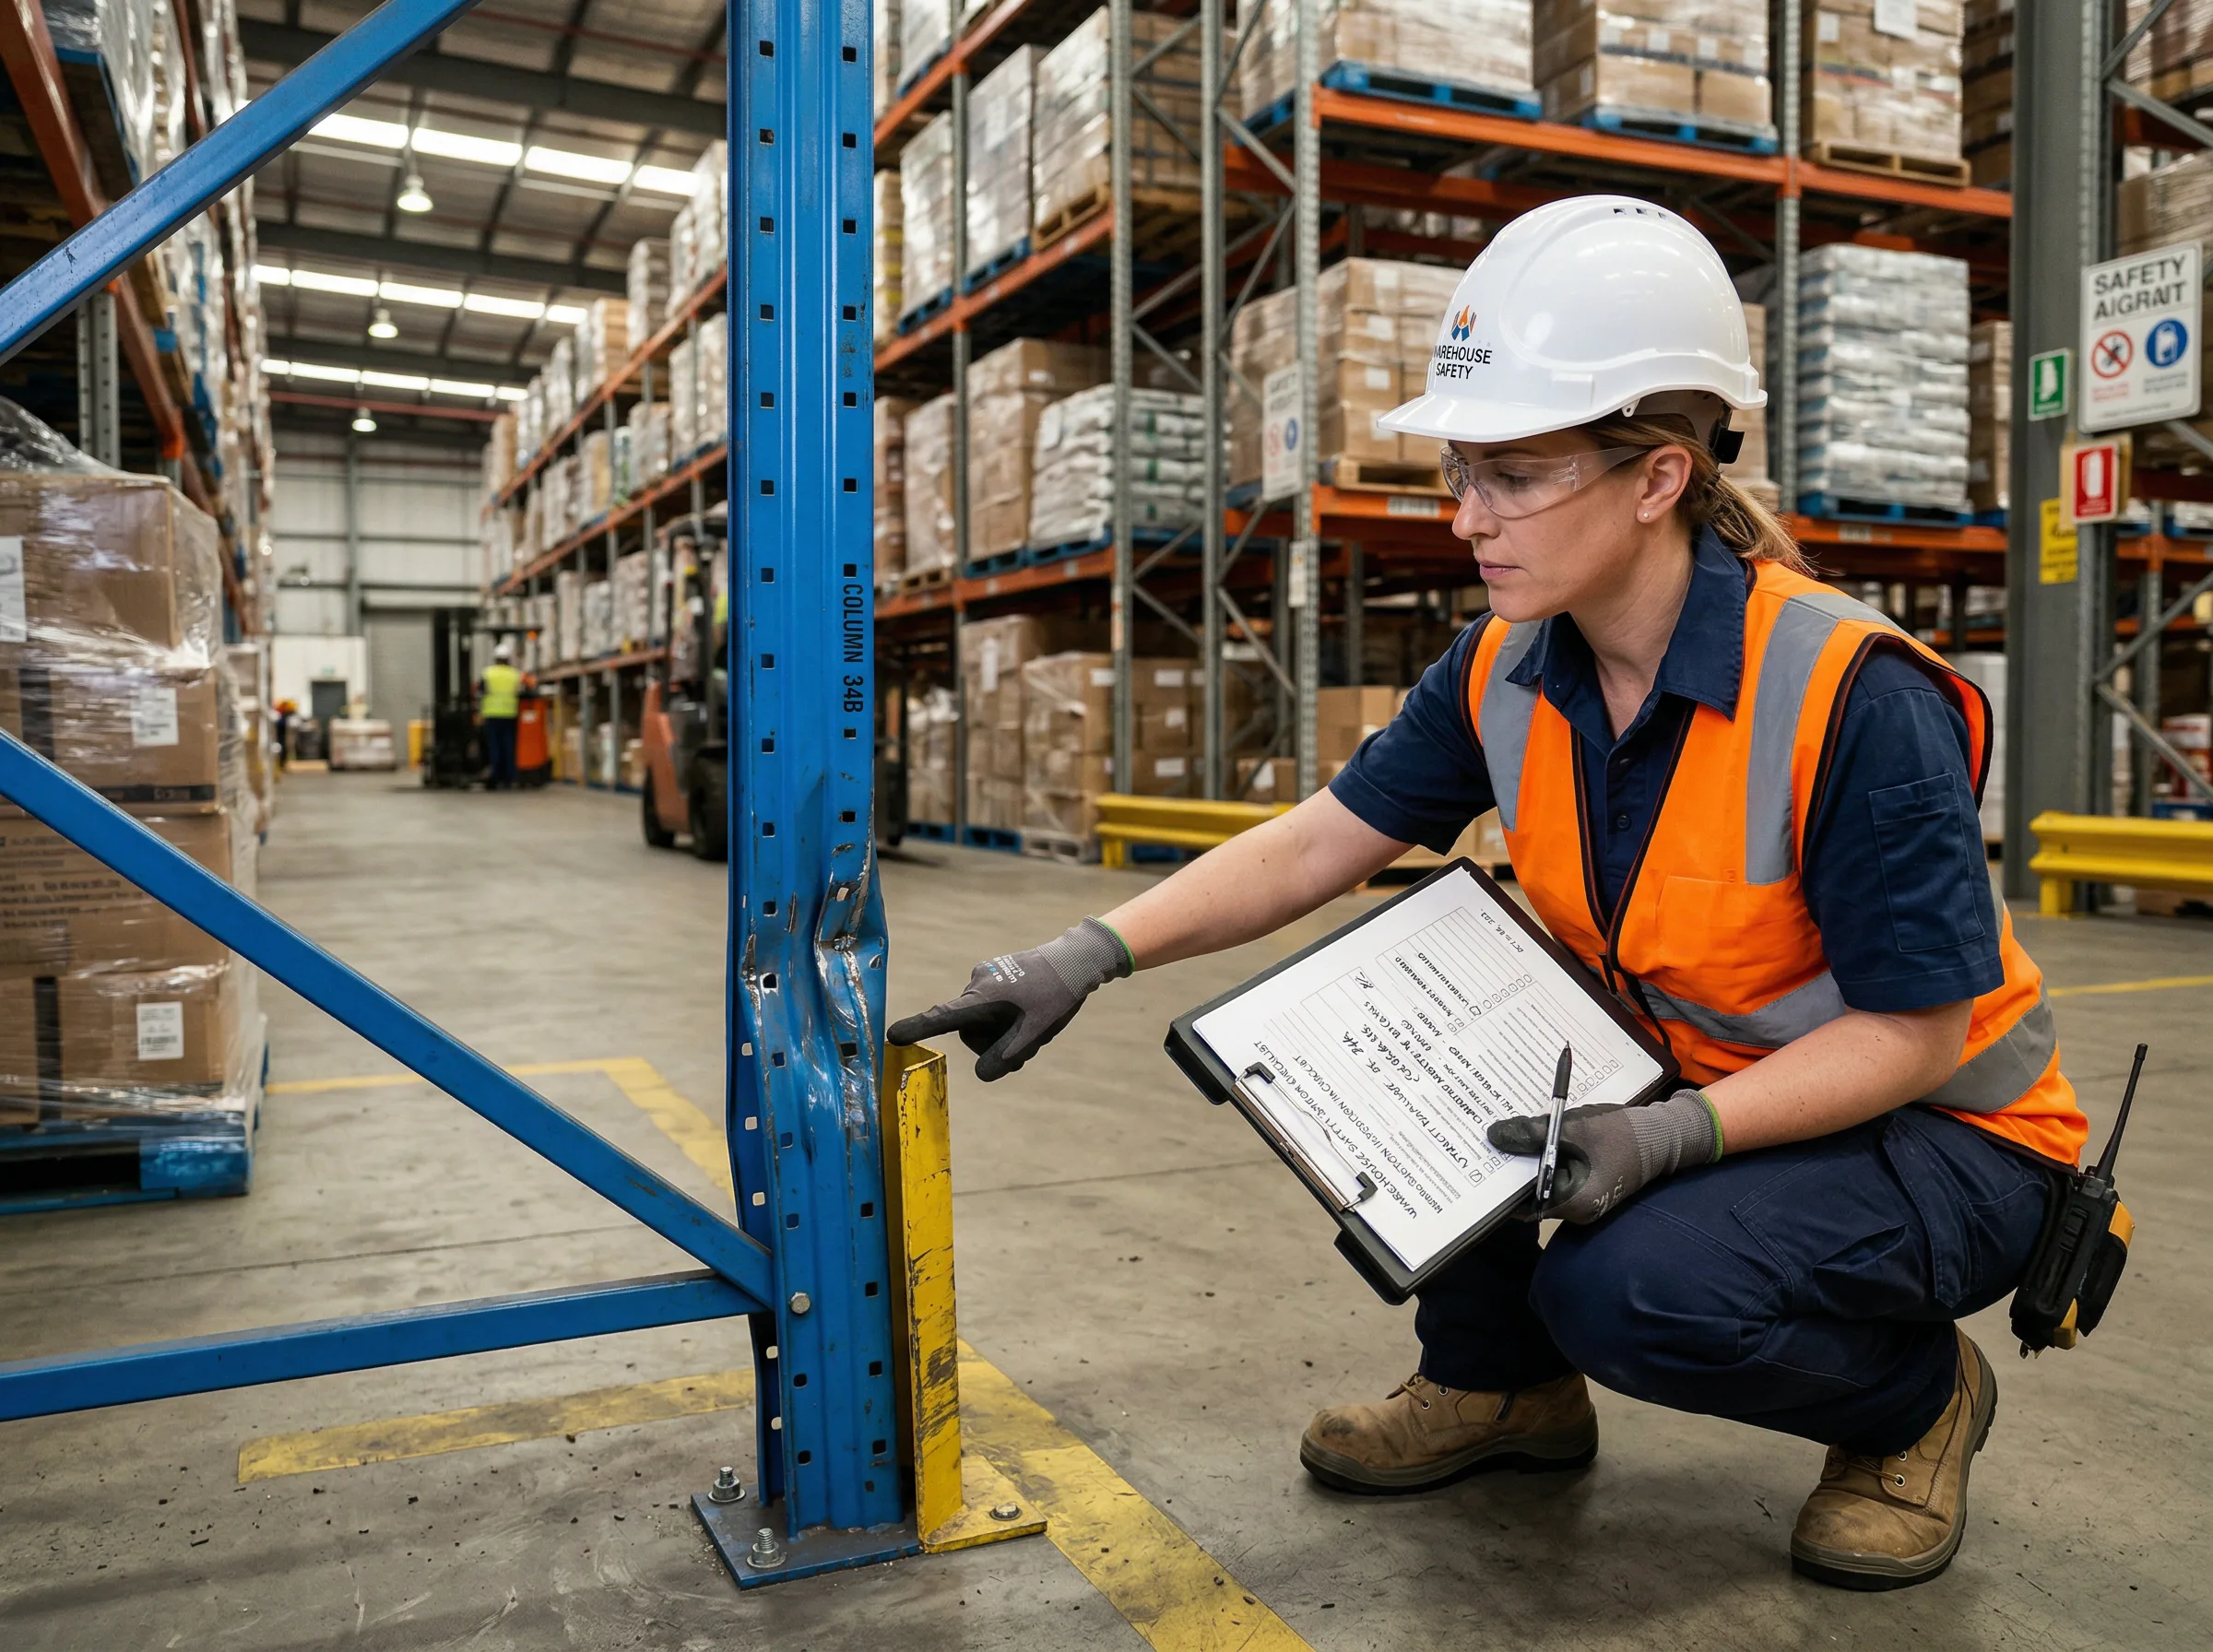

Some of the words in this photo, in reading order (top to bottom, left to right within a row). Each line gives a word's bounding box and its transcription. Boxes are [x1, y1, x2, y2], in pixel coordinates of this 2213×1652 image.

[2094, 254, 2185, 296] SAFETY
[1436, 362, 1473, 379] SAFETY
[843, 584, 863, 662] COLUMN
[843, 675, 863, 713] 34B
